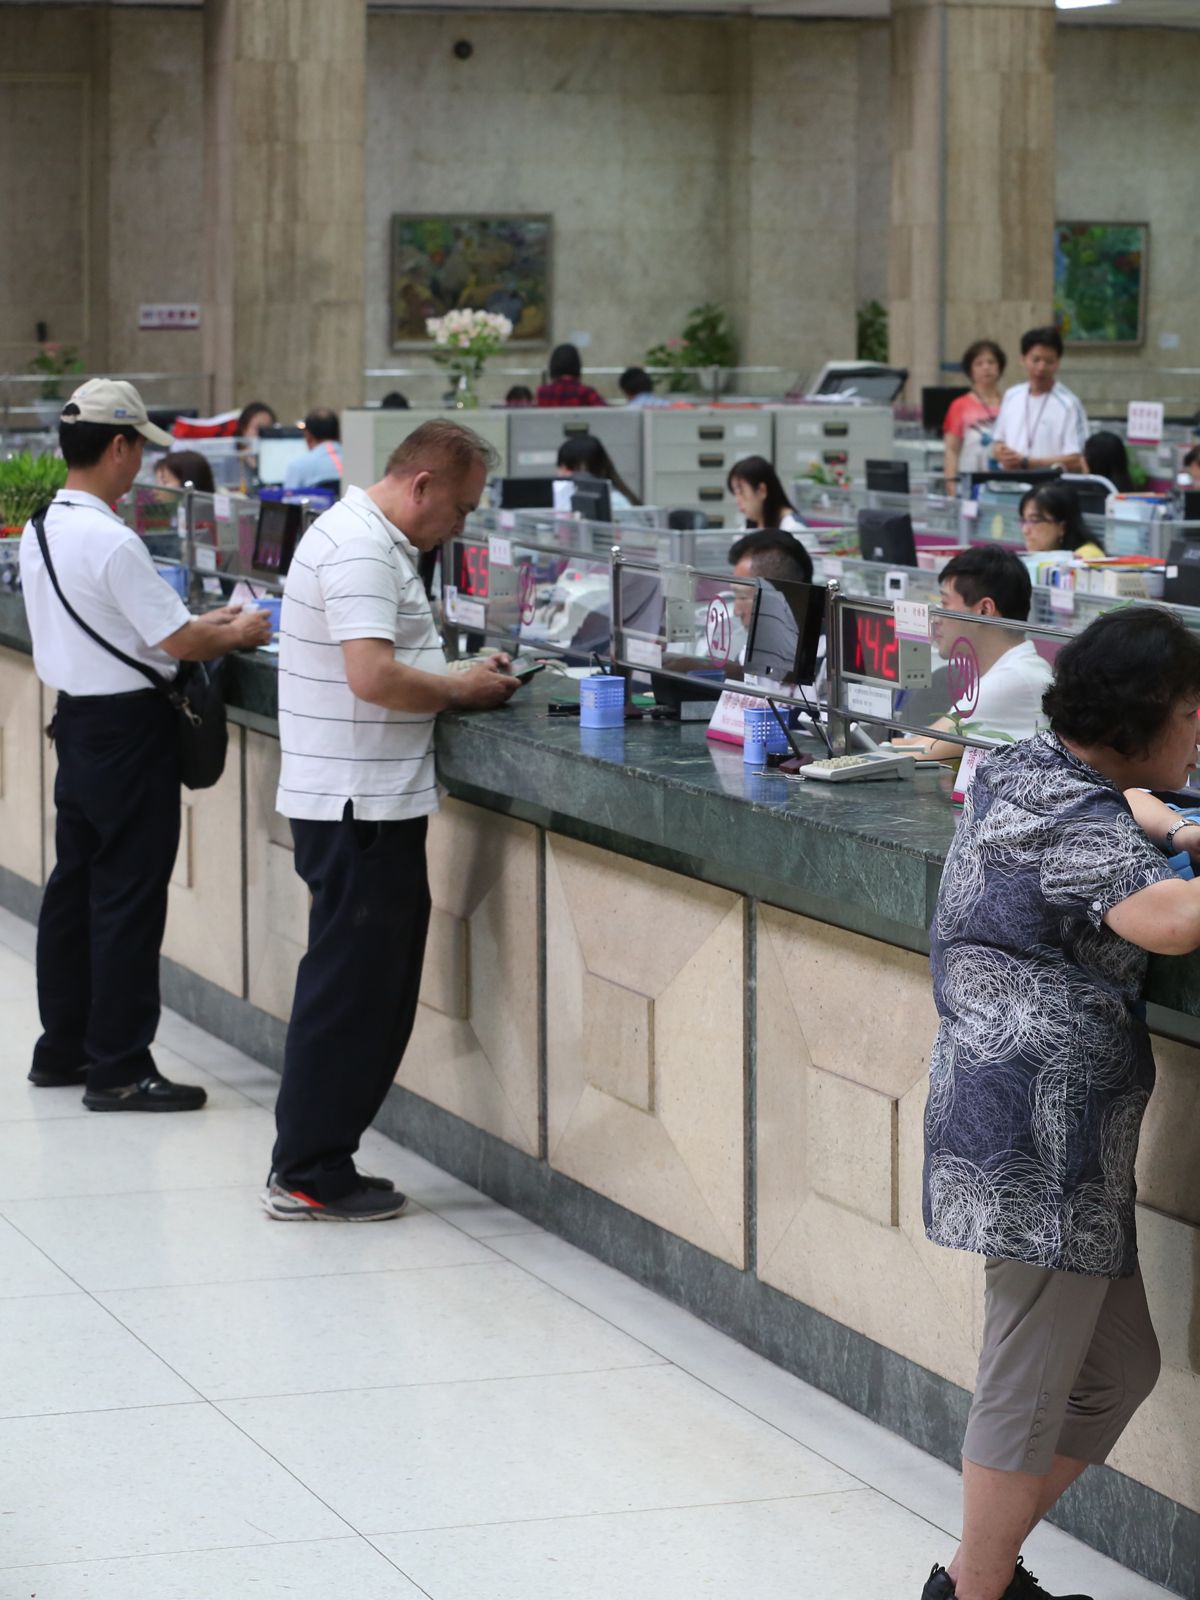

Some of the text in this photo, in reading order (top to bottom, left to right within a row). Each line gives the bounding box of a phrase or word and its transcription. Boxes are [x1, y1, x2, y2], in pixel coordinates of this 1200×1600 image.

[711, 607, 726, 652] 21
[855, 615, 899, 679] 142
[953, 651, 974, 702] 20
